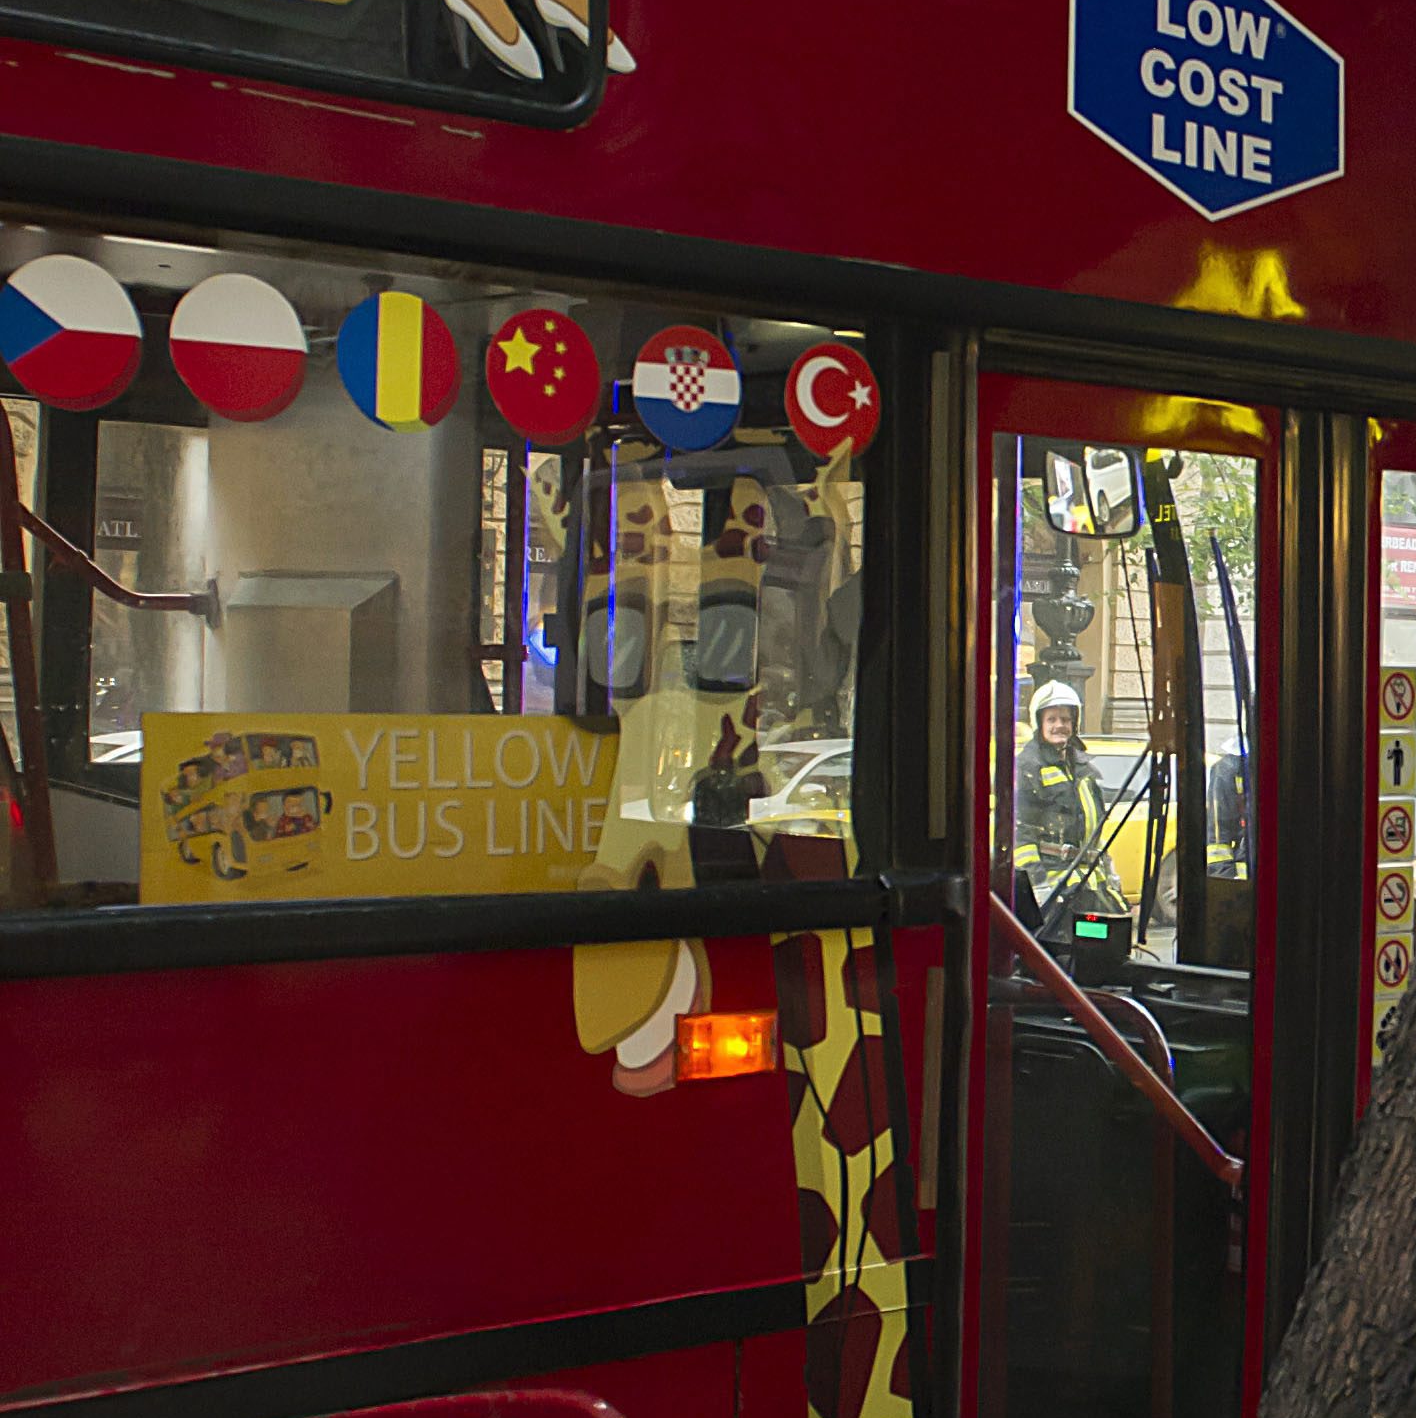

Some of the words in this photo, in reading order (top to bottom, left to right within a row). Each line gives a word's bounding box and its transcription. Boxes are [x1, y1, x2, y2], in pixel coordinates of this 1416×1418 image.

[1140, 49, 1284, 124] COST
[1151, 113, 1272, 184] LINE
[97, 520, 141, 538] ATL
[342, 728, 602, 791] YELLOW
[346, 799, 465, 861] BUS
[486, 796, 606, 855] LINE
